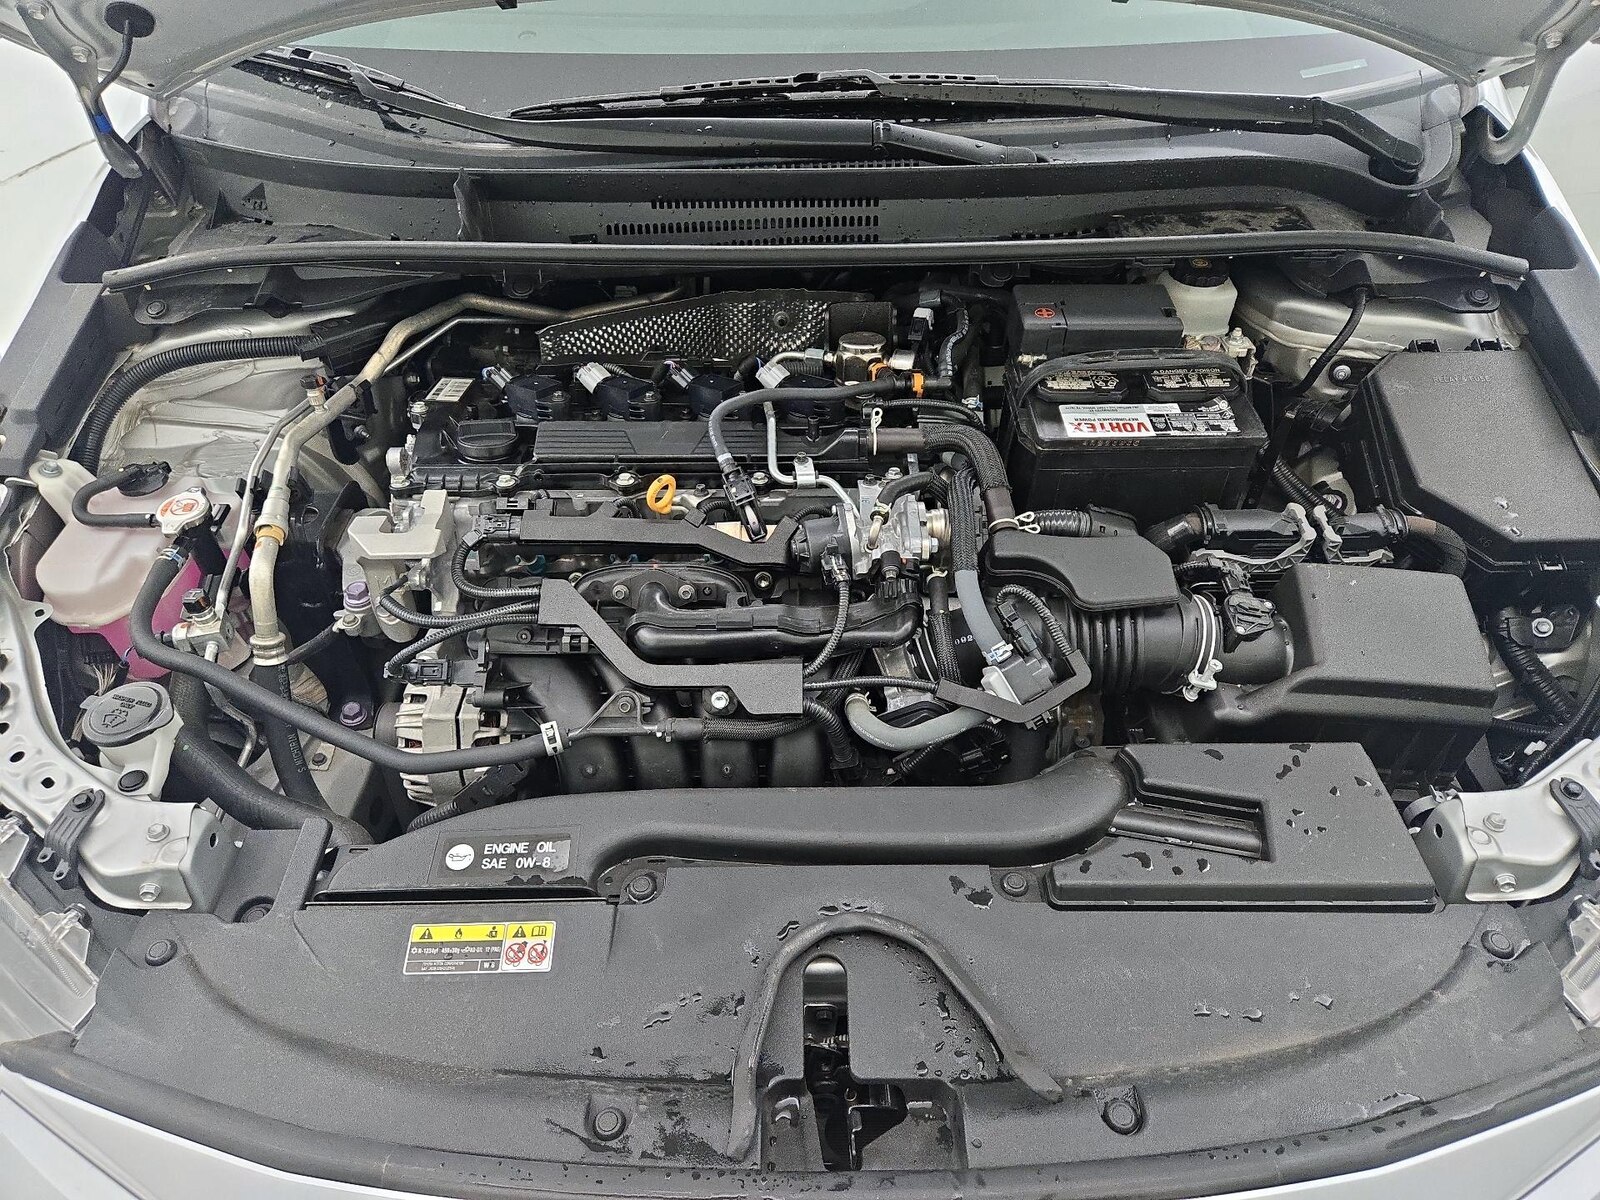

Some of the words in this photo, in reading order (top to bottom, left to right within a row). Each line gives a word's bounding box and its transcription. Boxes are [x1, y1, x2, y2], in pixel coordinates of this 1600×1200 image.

[1068, 421, 1151, 434] VORTEX
[483, 842, 530, 855] ENGINE
[536, 841, 556, 853] OIL
[481, 858, 507, 869] SAE
[515, 857, 551, 869] 0W-8
